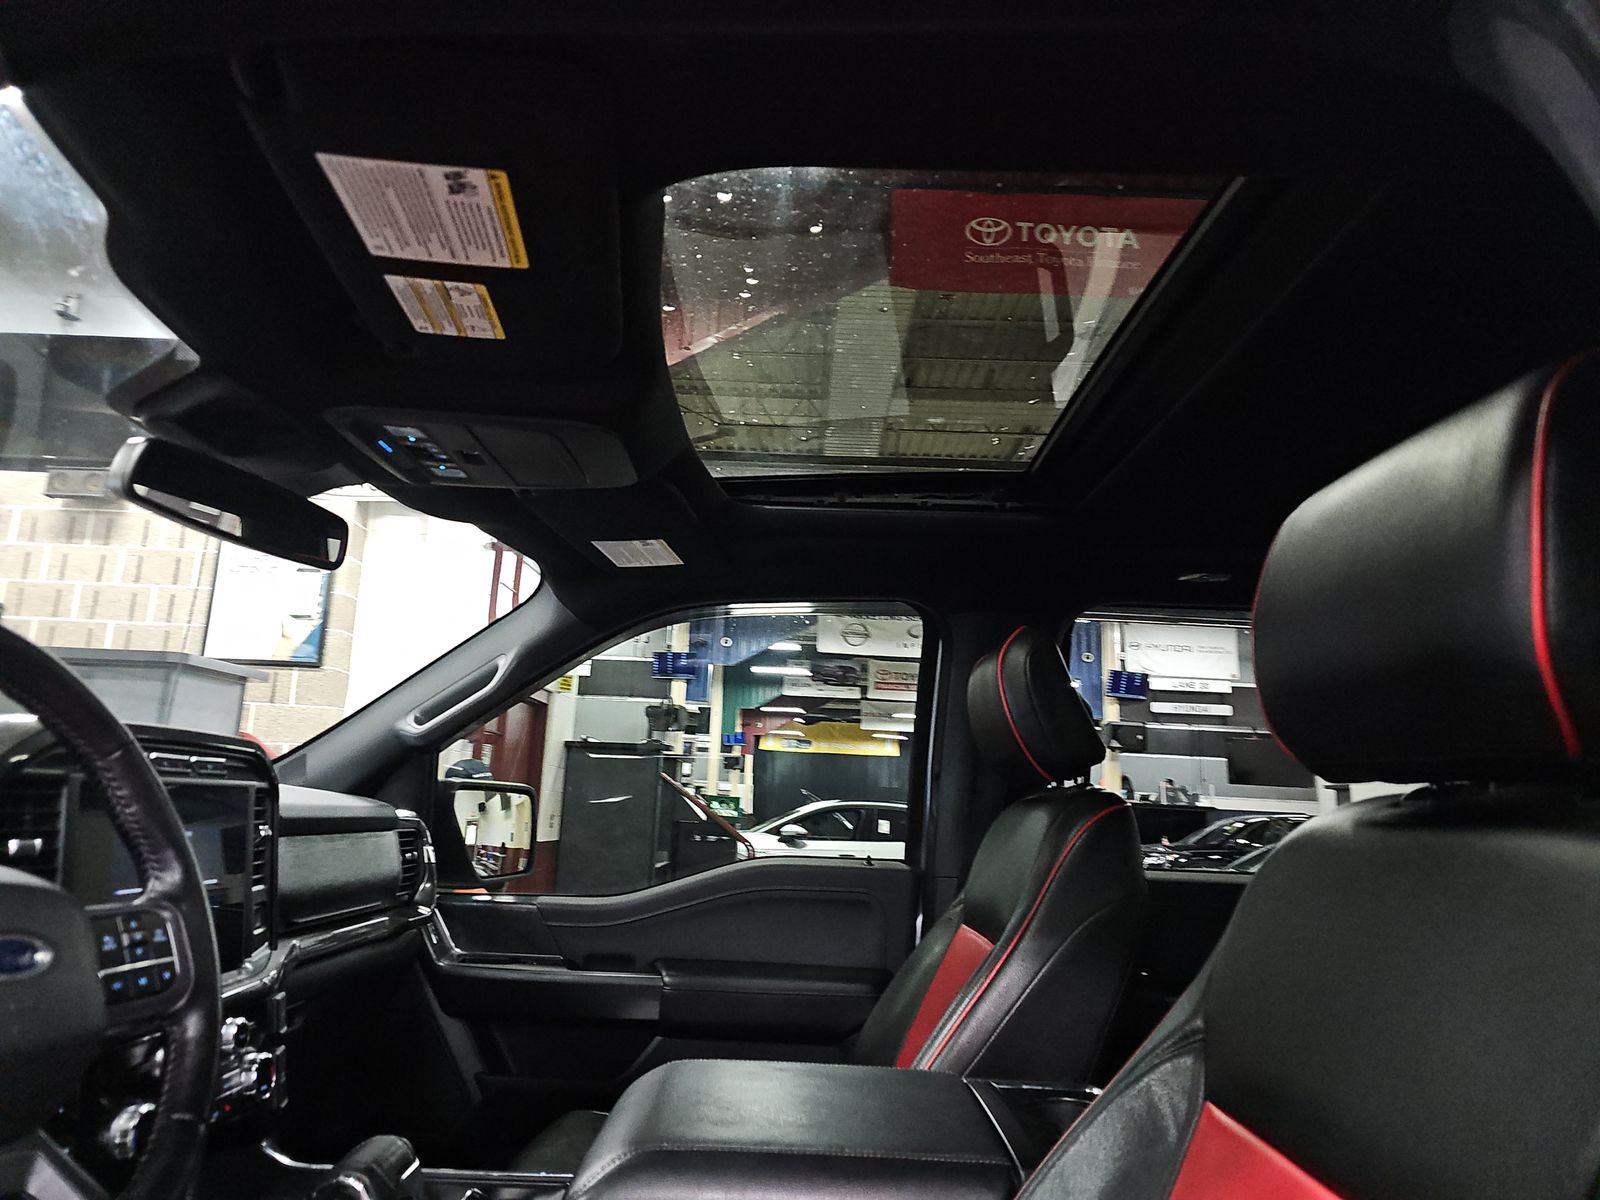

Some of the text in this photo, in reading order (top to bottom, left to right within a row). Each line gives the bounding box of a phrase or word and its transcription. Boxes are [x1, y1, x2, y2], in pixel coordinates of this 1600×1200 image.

[1015, 221, 1141, 249] TOYOTA
[964, 252, 1034, 265] Southeast
[1037, 253, 1086, 267] Toyota
[1171, 681, 1196, 690] LANE
